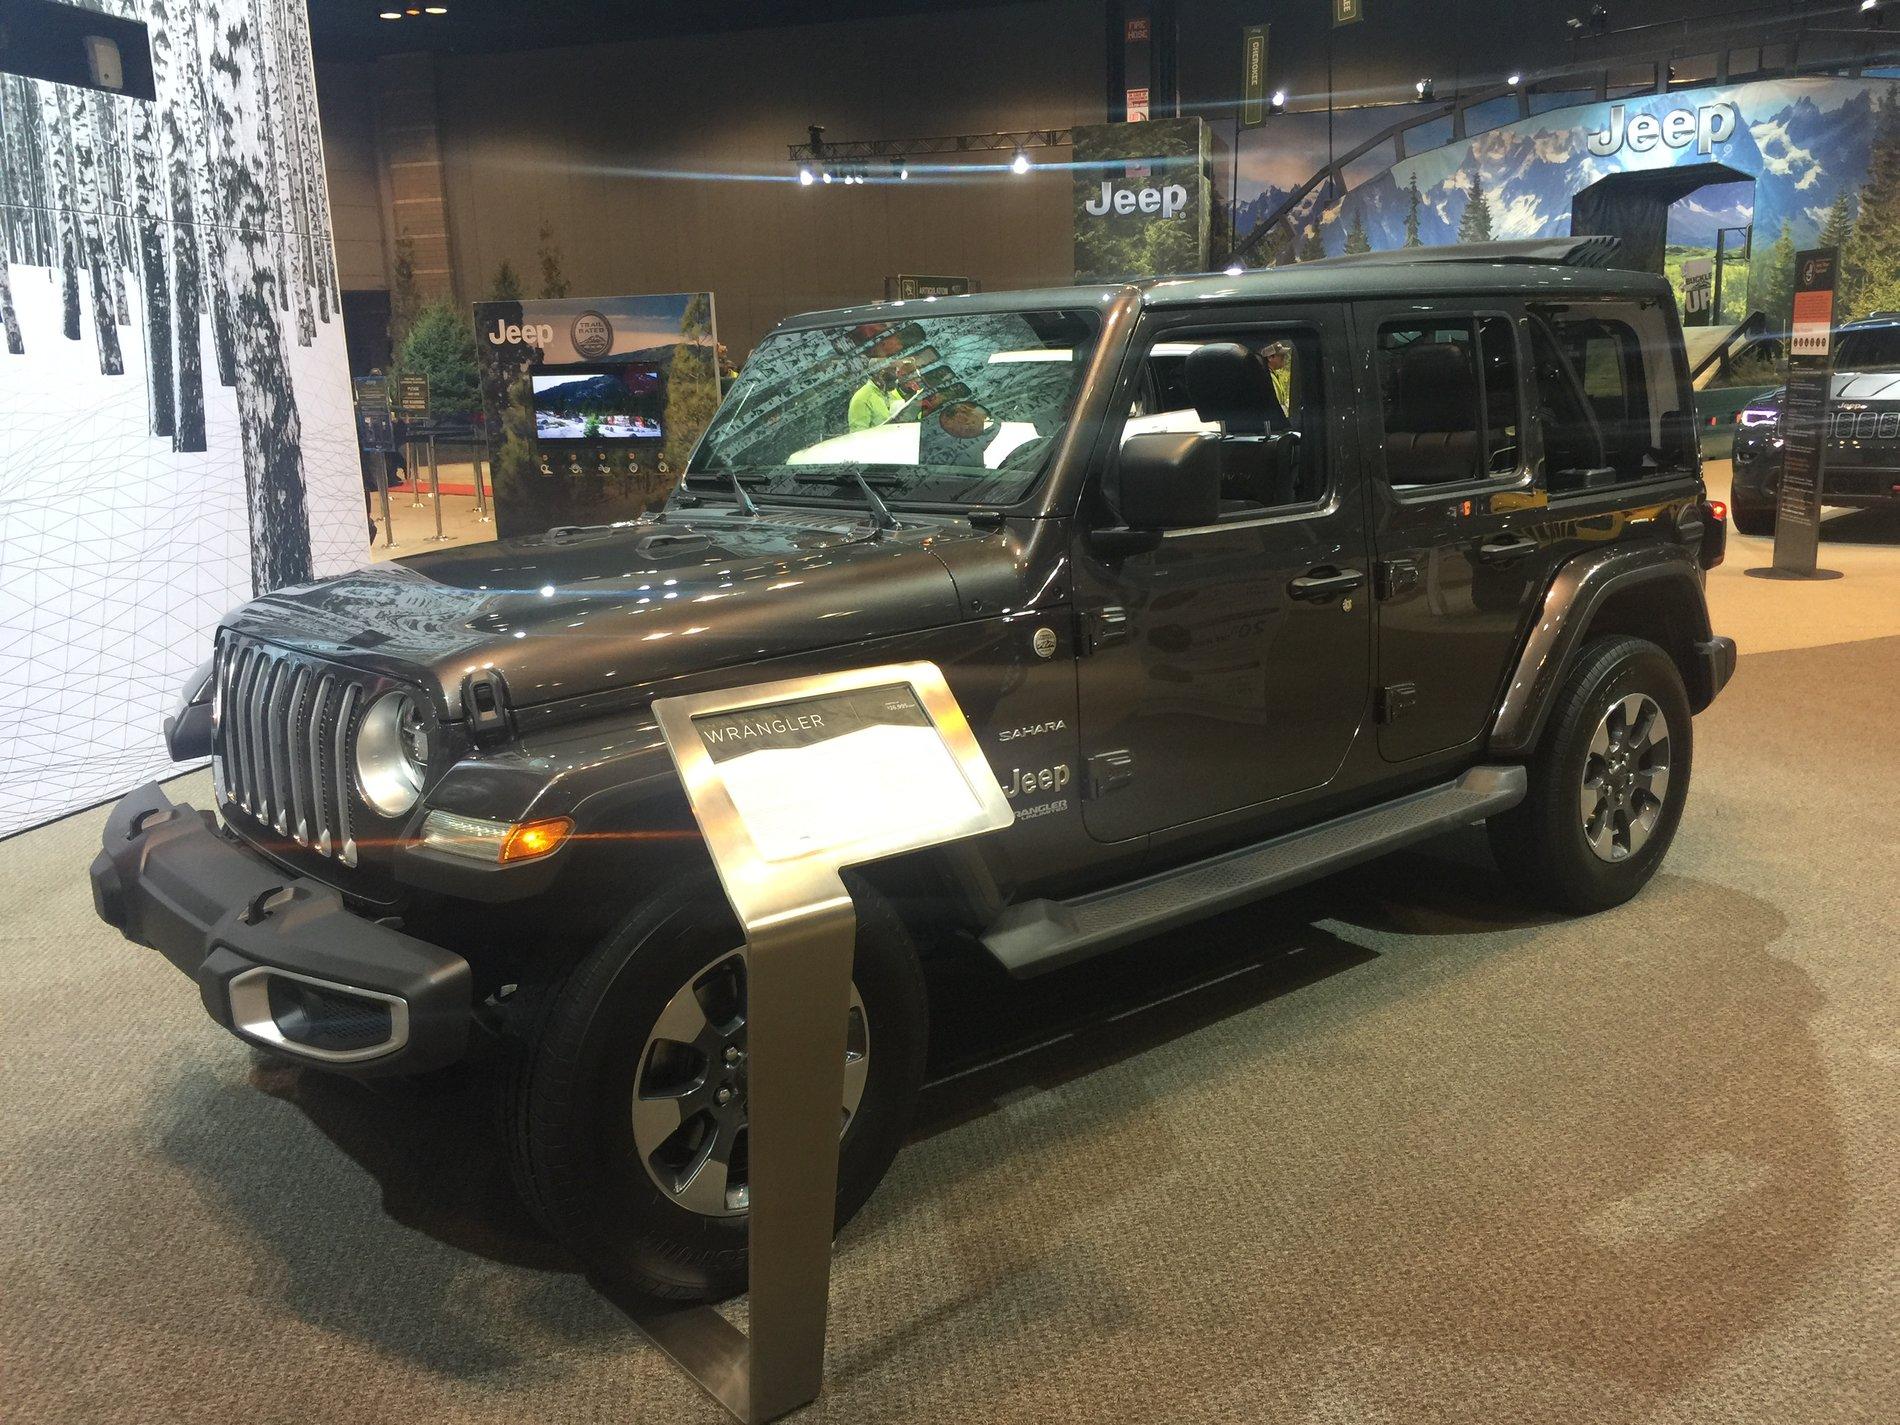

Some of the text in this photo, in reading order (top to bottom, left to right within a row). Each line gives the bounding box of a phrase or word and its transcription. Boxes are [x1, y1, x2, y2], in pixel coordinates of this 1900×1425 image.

[1251, 41, 1260, 86] CHEROKEE
[1587, 103, 1736, 157] Jeep
[1085, 181, 1187, 218] Jeep
[1686, 288, 1712, 313] UP
[489, 319, 554, 348] Jeep
[1837, 402, 1861, 410] Jeep
[704, 714, 825, 744] WRANGLER
[999, 720, 1067, 742] SAHARA
[1002, 764, 1071, 799] Jeep
[1014, 800, 1068, 818] RANGLER
